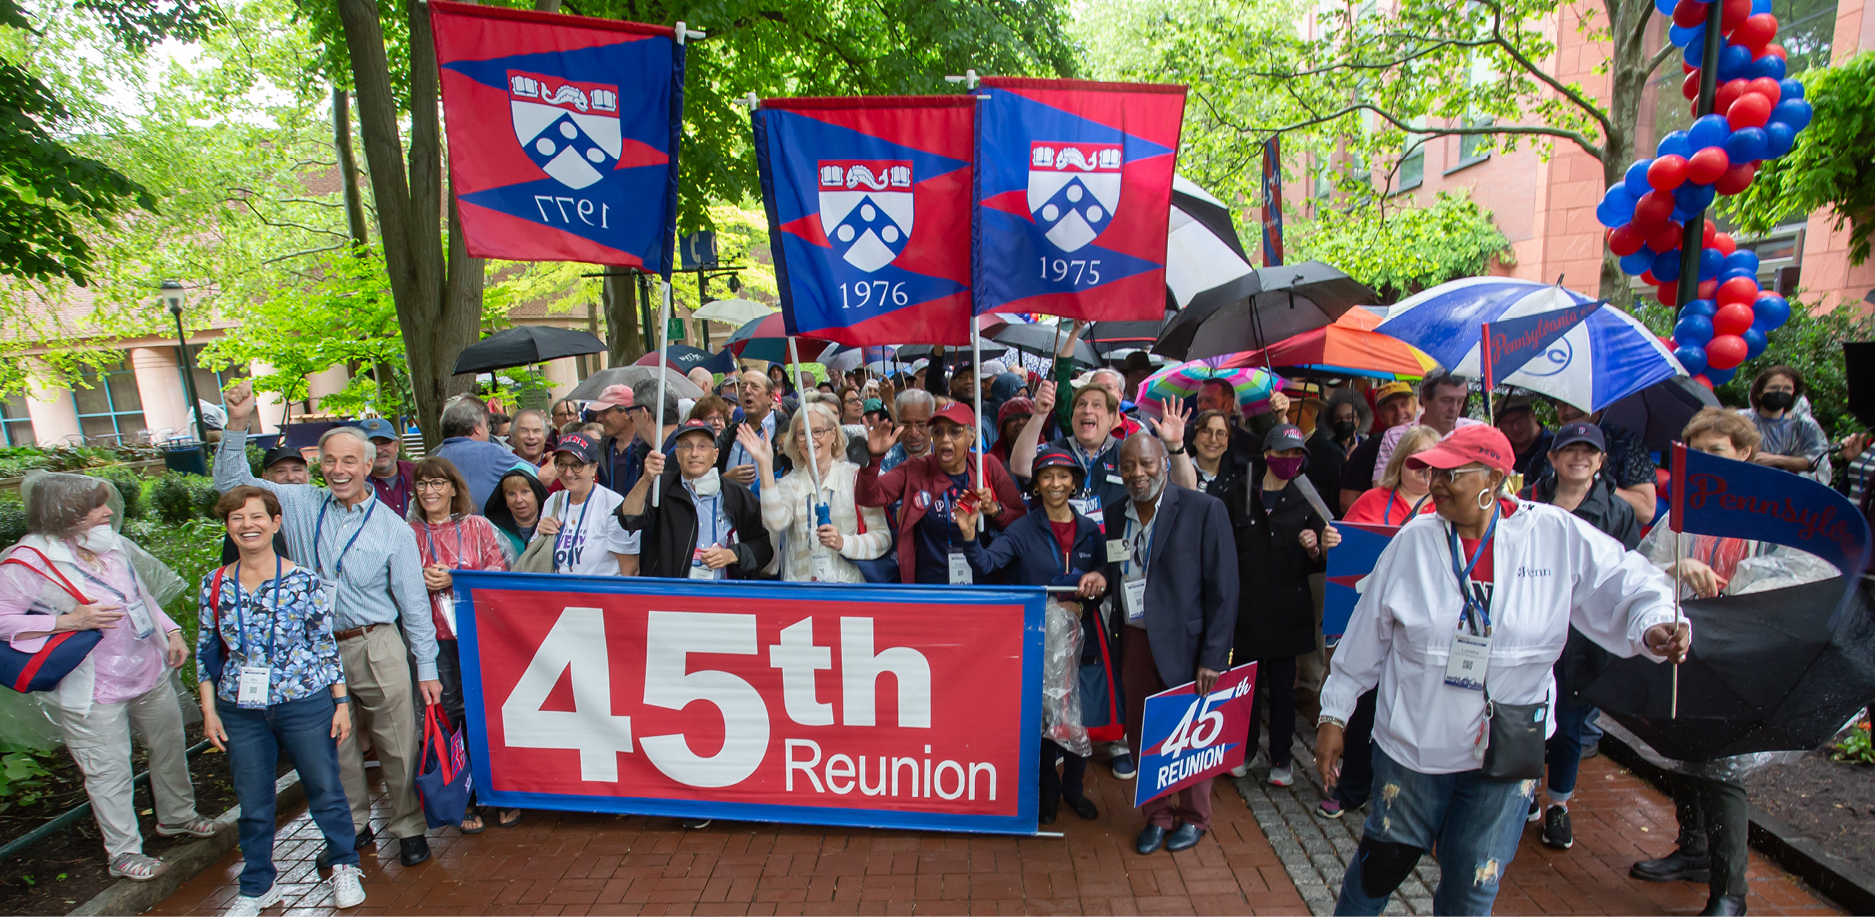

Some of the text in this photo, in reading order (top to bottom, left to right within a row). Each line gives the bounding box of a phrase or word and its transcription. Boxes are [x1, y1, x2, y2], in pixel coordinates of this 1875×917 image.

[1040, 256, 1101, 286] 1975
[839, 280, 908, 309] 1976
[1491, 310, 1578, 365] Pennsylvania
[559, 434, 589, 449] PENN
[1479, 446, 1501, 461] PENN
[1522, 566, 1551, 578] Penn
[501, 606, 931, 788] 45th
[1160, 675, 1252, 760] 45th
[785, 738, 997, 801] Reunion
[1156, 742, 1226, 790] REUNION
